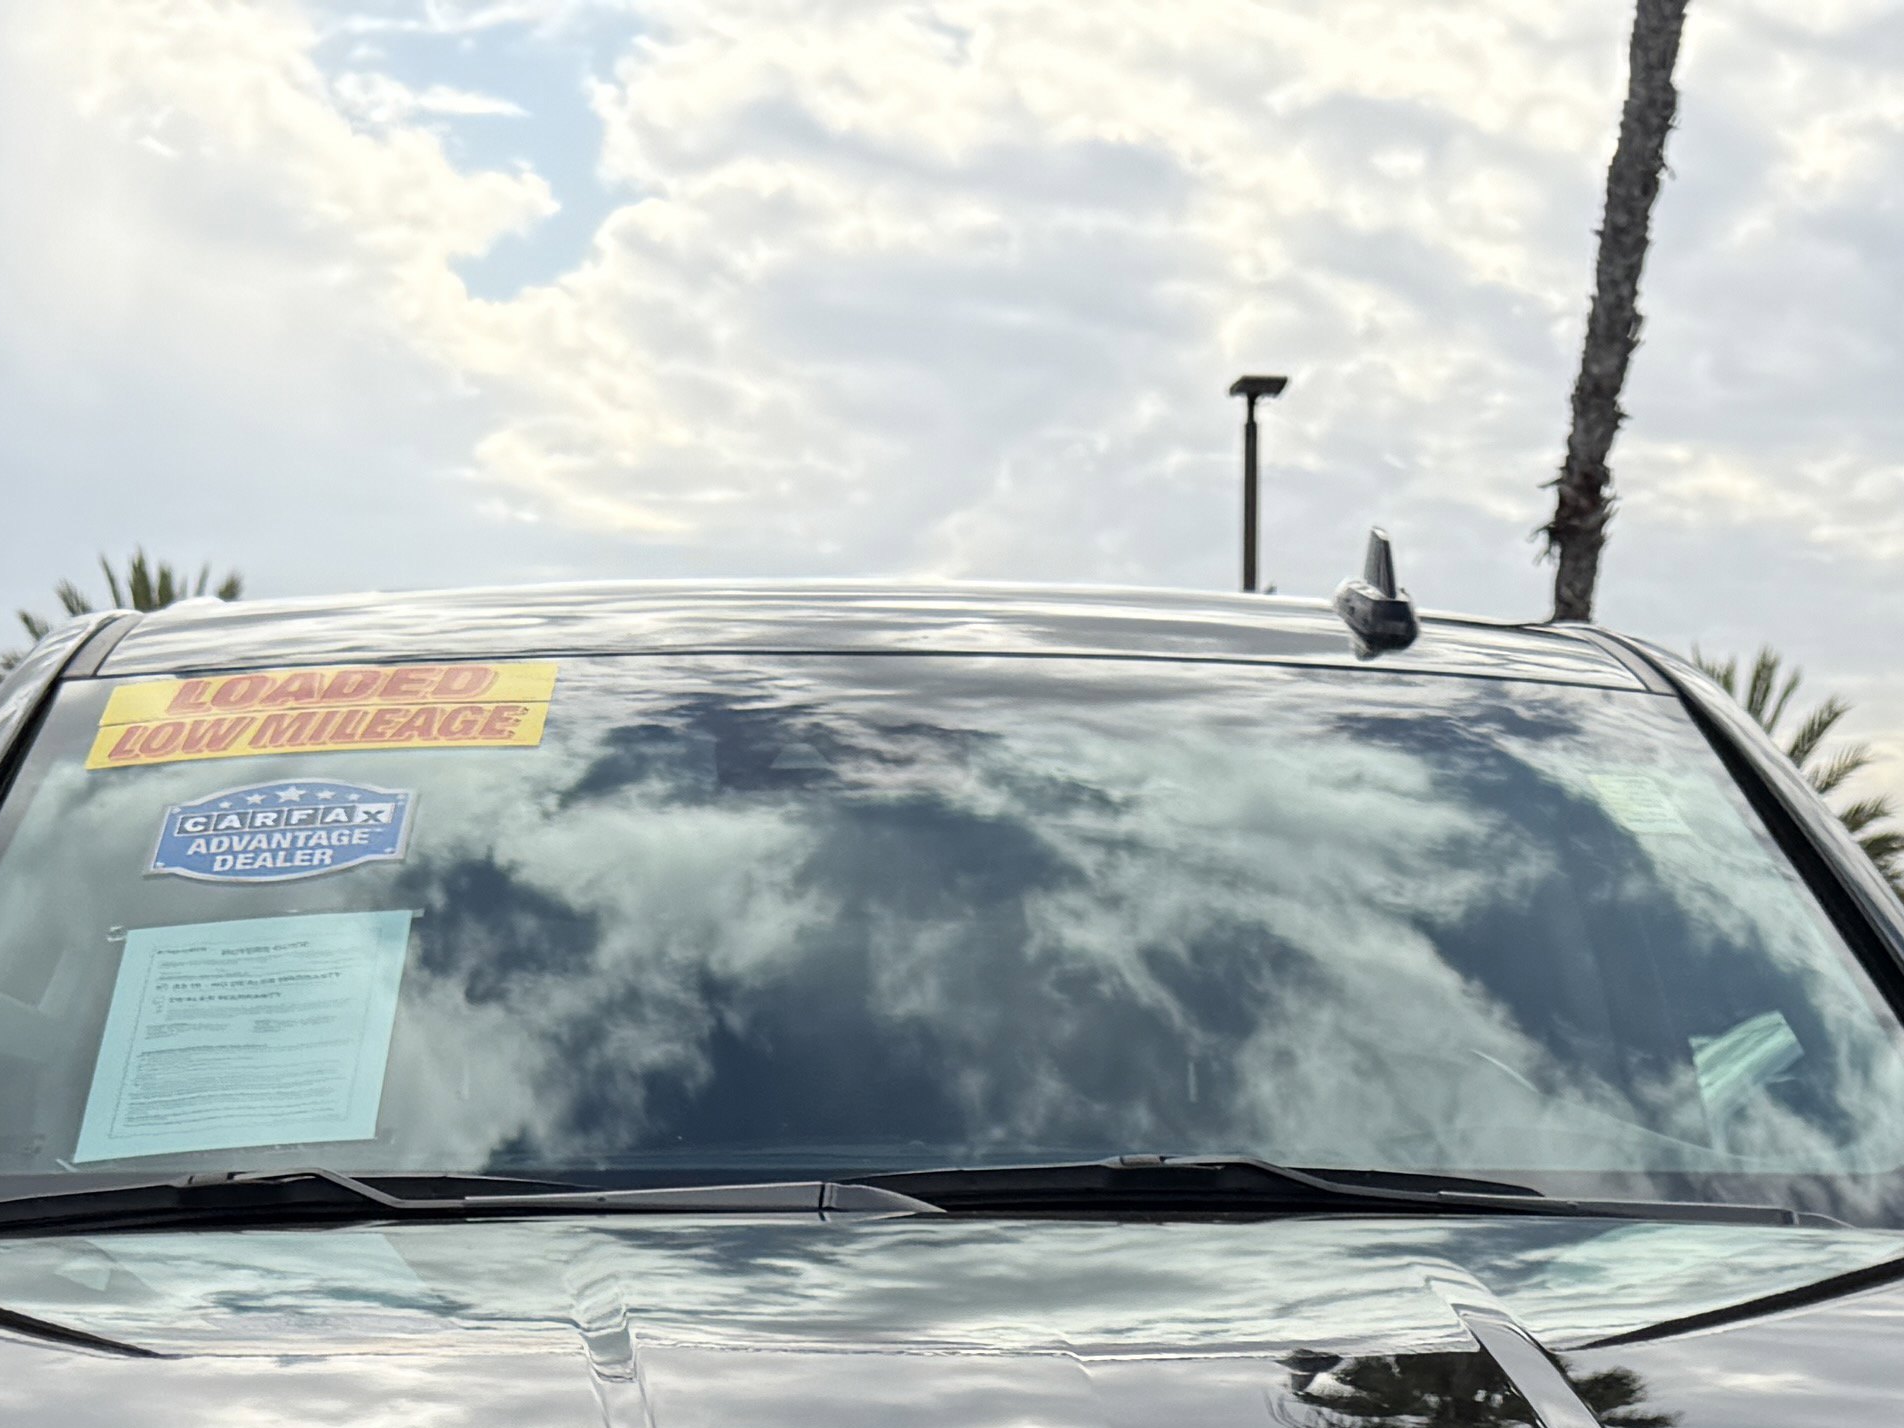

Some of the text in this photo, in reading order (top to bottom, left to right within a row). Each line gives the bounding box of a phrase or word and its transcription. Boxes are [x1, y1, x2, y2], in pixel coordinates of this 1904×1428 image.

[165, 664, 500, 717] LOADED
[107, 704, 530, 762] LOW MILEAGE
[178, 804, 393, 835] CARFAX
[186, 828, 371, 856] ADVANTAGE
[212, 848, 334, 872] DEALER
